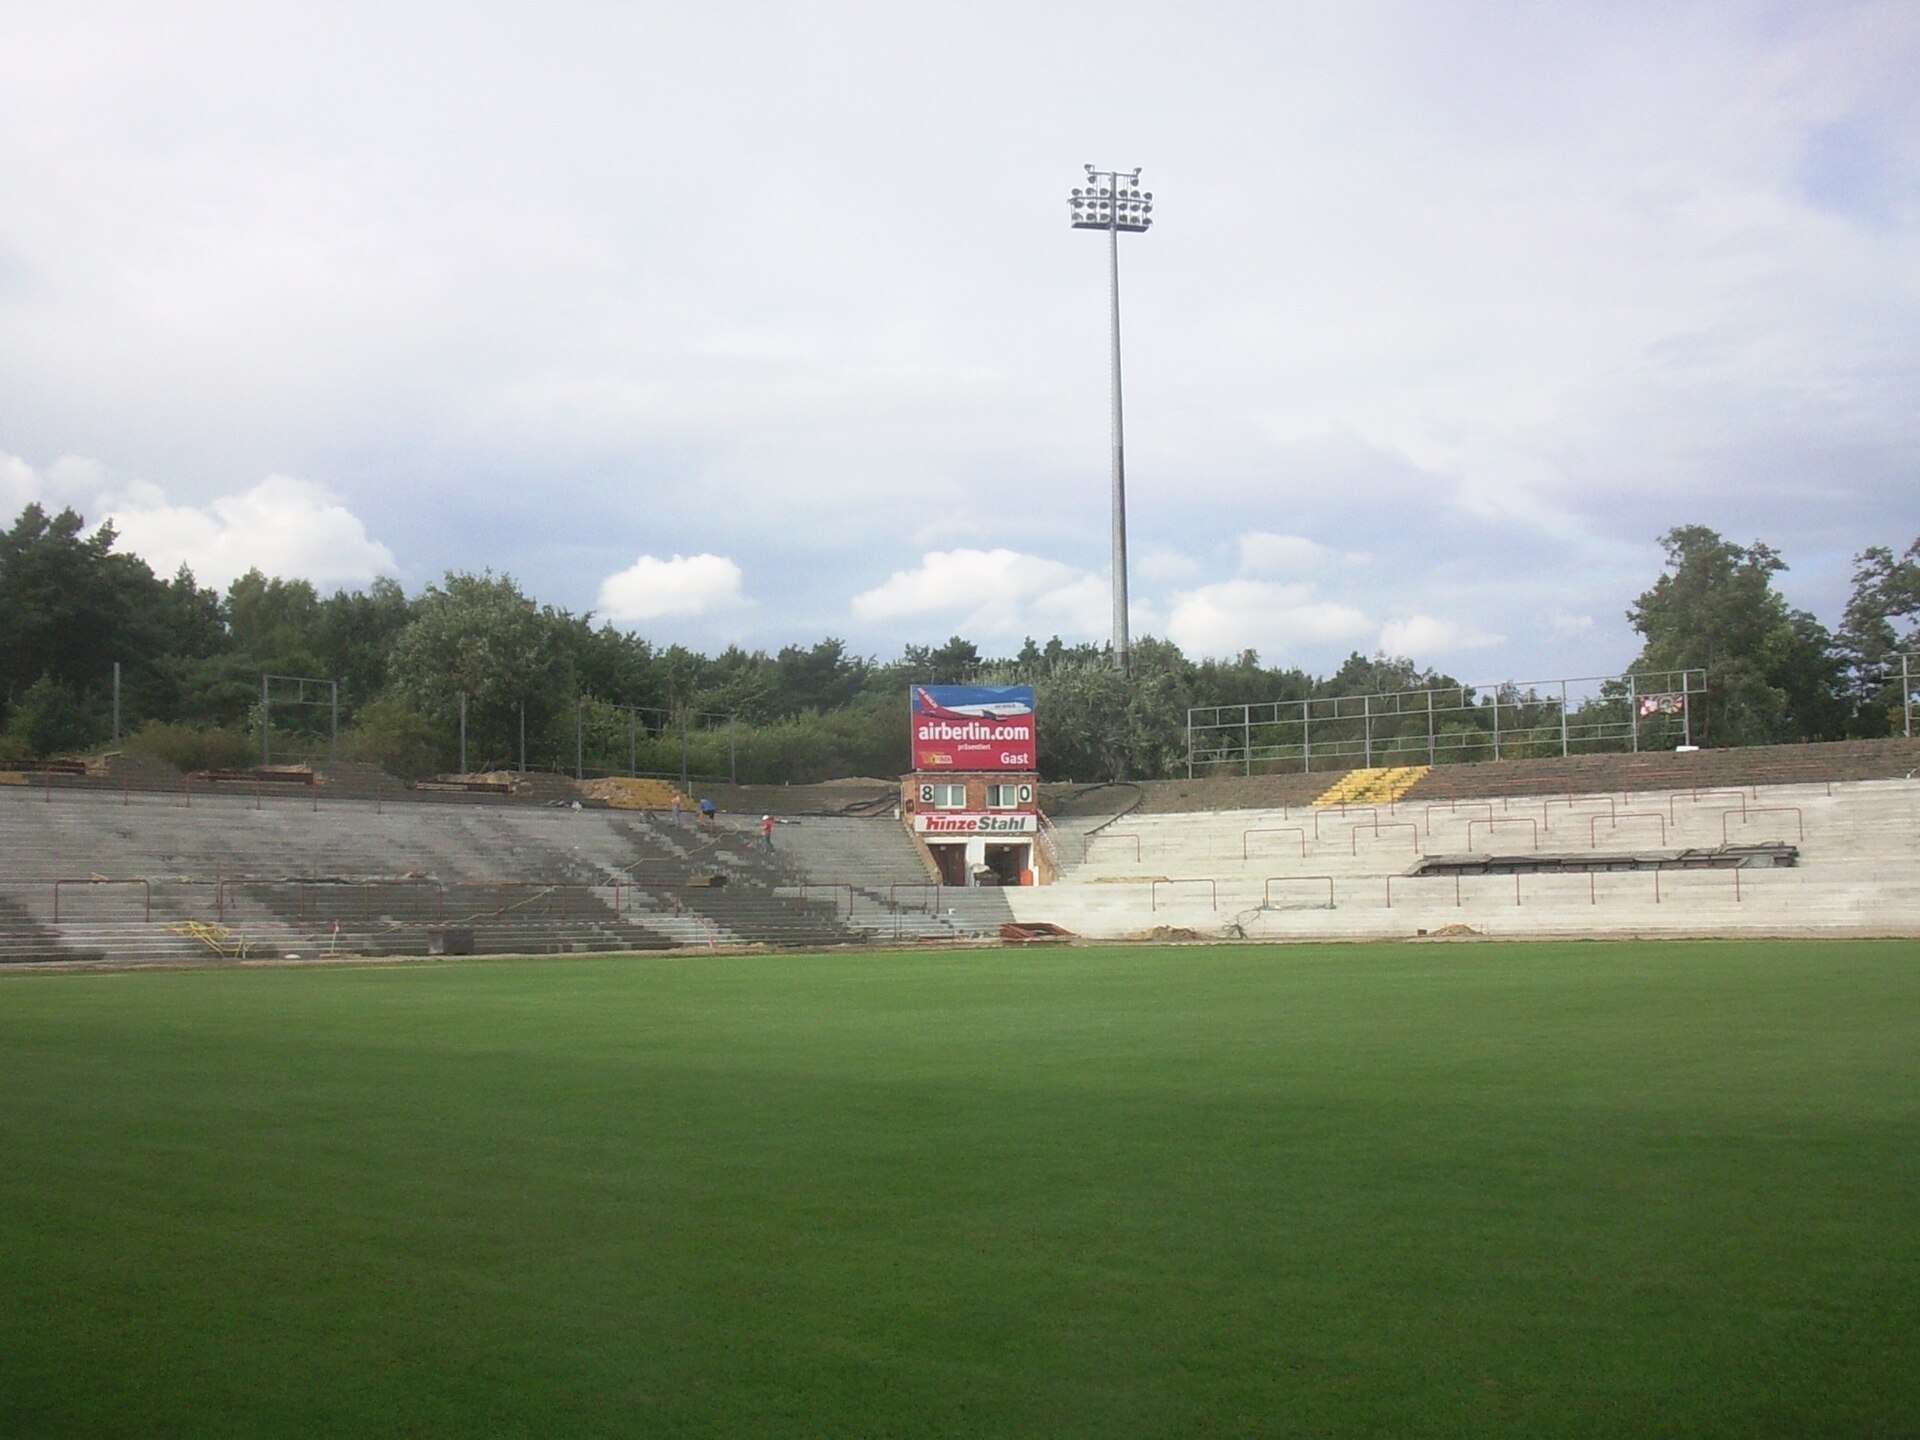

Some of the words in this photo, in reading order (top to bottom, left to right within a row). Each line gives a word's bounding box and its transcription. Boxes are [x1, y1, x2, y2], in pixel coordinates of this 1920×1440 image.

[919, 722, 1029, 740] airberlin.com
[1001, 752, 1029, 764] Gast
[922, 786, 933, 801] 8
